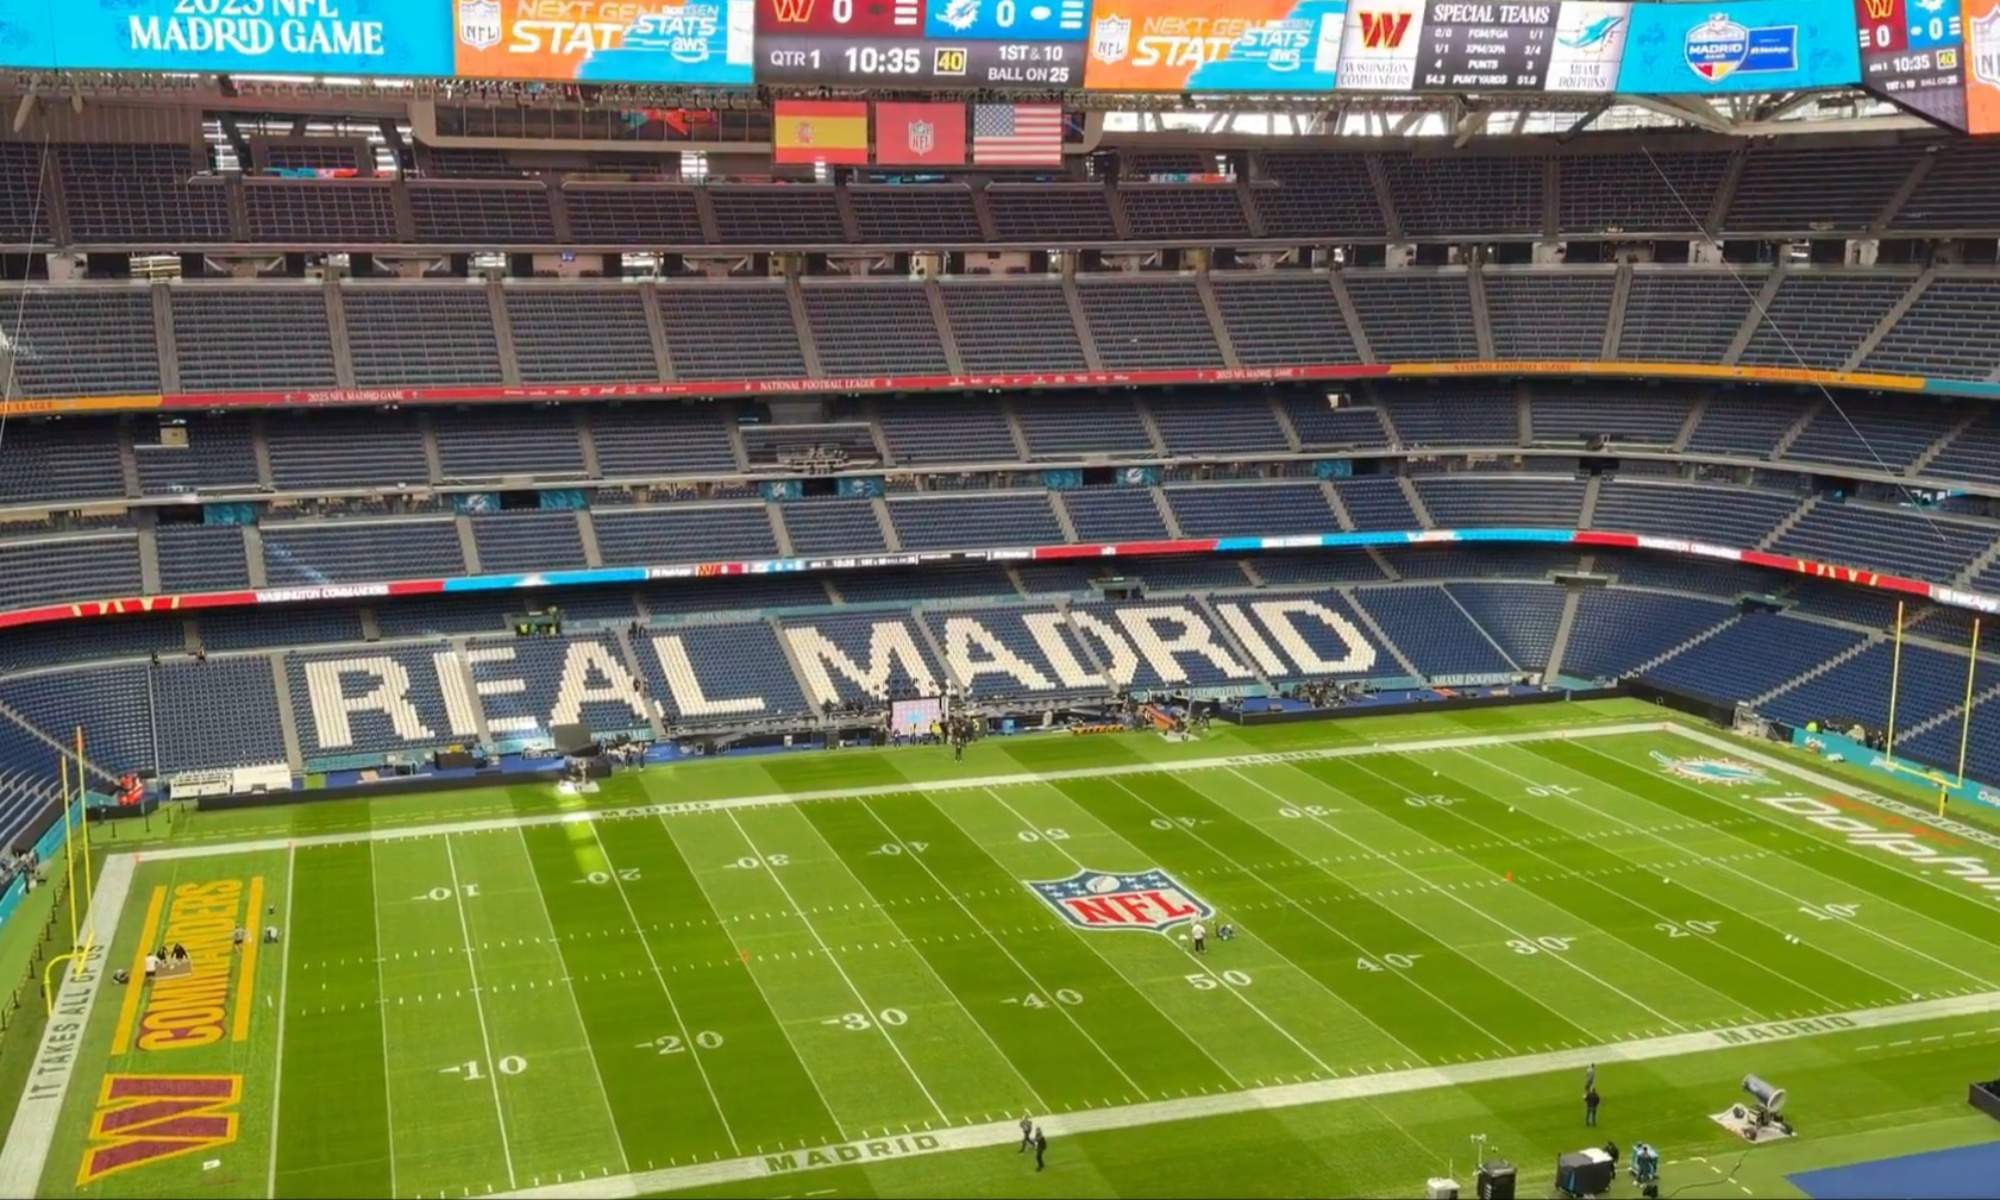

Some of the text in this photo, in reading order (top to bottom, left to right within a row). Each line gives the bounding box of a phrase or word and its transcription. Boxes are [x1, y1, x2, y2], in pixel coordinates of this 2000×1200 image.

[516, 0, 595, 18] NEXT
[832, 0, 853, 23] 0
[996, 2, 1016, 28] 0
[1433, 4, 1551, 24] SPECIAL TEAMS
[465, 25, 497, 41] NFL
[636, 14, 718, 37] STATS
[1143, 16, 1206, 33] NEXT
[1928, 17, 1944, 40] 0
[128, 15, 385, 56] MADRID GAME
[508, 20, 630, 58] STAT
[671, 36, 708, 54] aws
[1240, 28, 1312, 48] STATS
[1876, 24, 1890, 47] 0
[1000, 45, 1064, 62] 1ST & 10
[1132, 36, 1236, 69] STAT
[1689, 43, 1743, 55] MADRID
[771, 50, 822, 69] QTR 1
[845, 48, 921, 74] 10:35
[938, 52, 964, 71] 40
[1467, 60, 1499, 70] PUNTS
[1893, 54, 1931, 73] 10:35
[988, 67, 1070, 83] BALL ON 25
[1452, 74, 1477, 85] PUNT
[760, 379, 876, 391] NATIONAL FOOTBALL LEAGUE
[346, 392, 379, 401] MADRID
[305, 600, 1376, 748] REAL MADRID
[601, 803, 709, 816] MADRID
[1404, 794, 1454, 809] 20
[1278, 804, 1330, 819] 30
[1150, 815, 1197, 831] 40
[1018, 827, 1070, 843] 50
[881, 839, 929, 856] 40
[1755, 796, 2000, 902] Dolphi
[737, 853, 790, 870] 30
[587, 867, 641, 885] 20
[428, 882, 480, 901] 10
[1066, 891, 1201, 925] NFL
[1798, 903, 1857, 922] 10
[1655, 919, 1717, 938] 20
[1506, 935, 1570, 956] 30
[137, 879, 243, 1051] COMMANDERS
[1357, 952, 1414, 972] 40
[1185, 969, 1252, 991] 50
[58, 987, 92, 1016] ALL
[1022, 987, 1084, 1010] 40
[842, 1007, 908, 1032] 30
[1712, 1015, 1857, 1045] MADRID
[37, 1022, 80, 1076] TAKES
[655, 1030, 724, 1055] 20
[462, 1054, 528, 1081] 10
[28, 1083, 61, 1101] IT
[765, 1134, 942, 1173] MADRID
